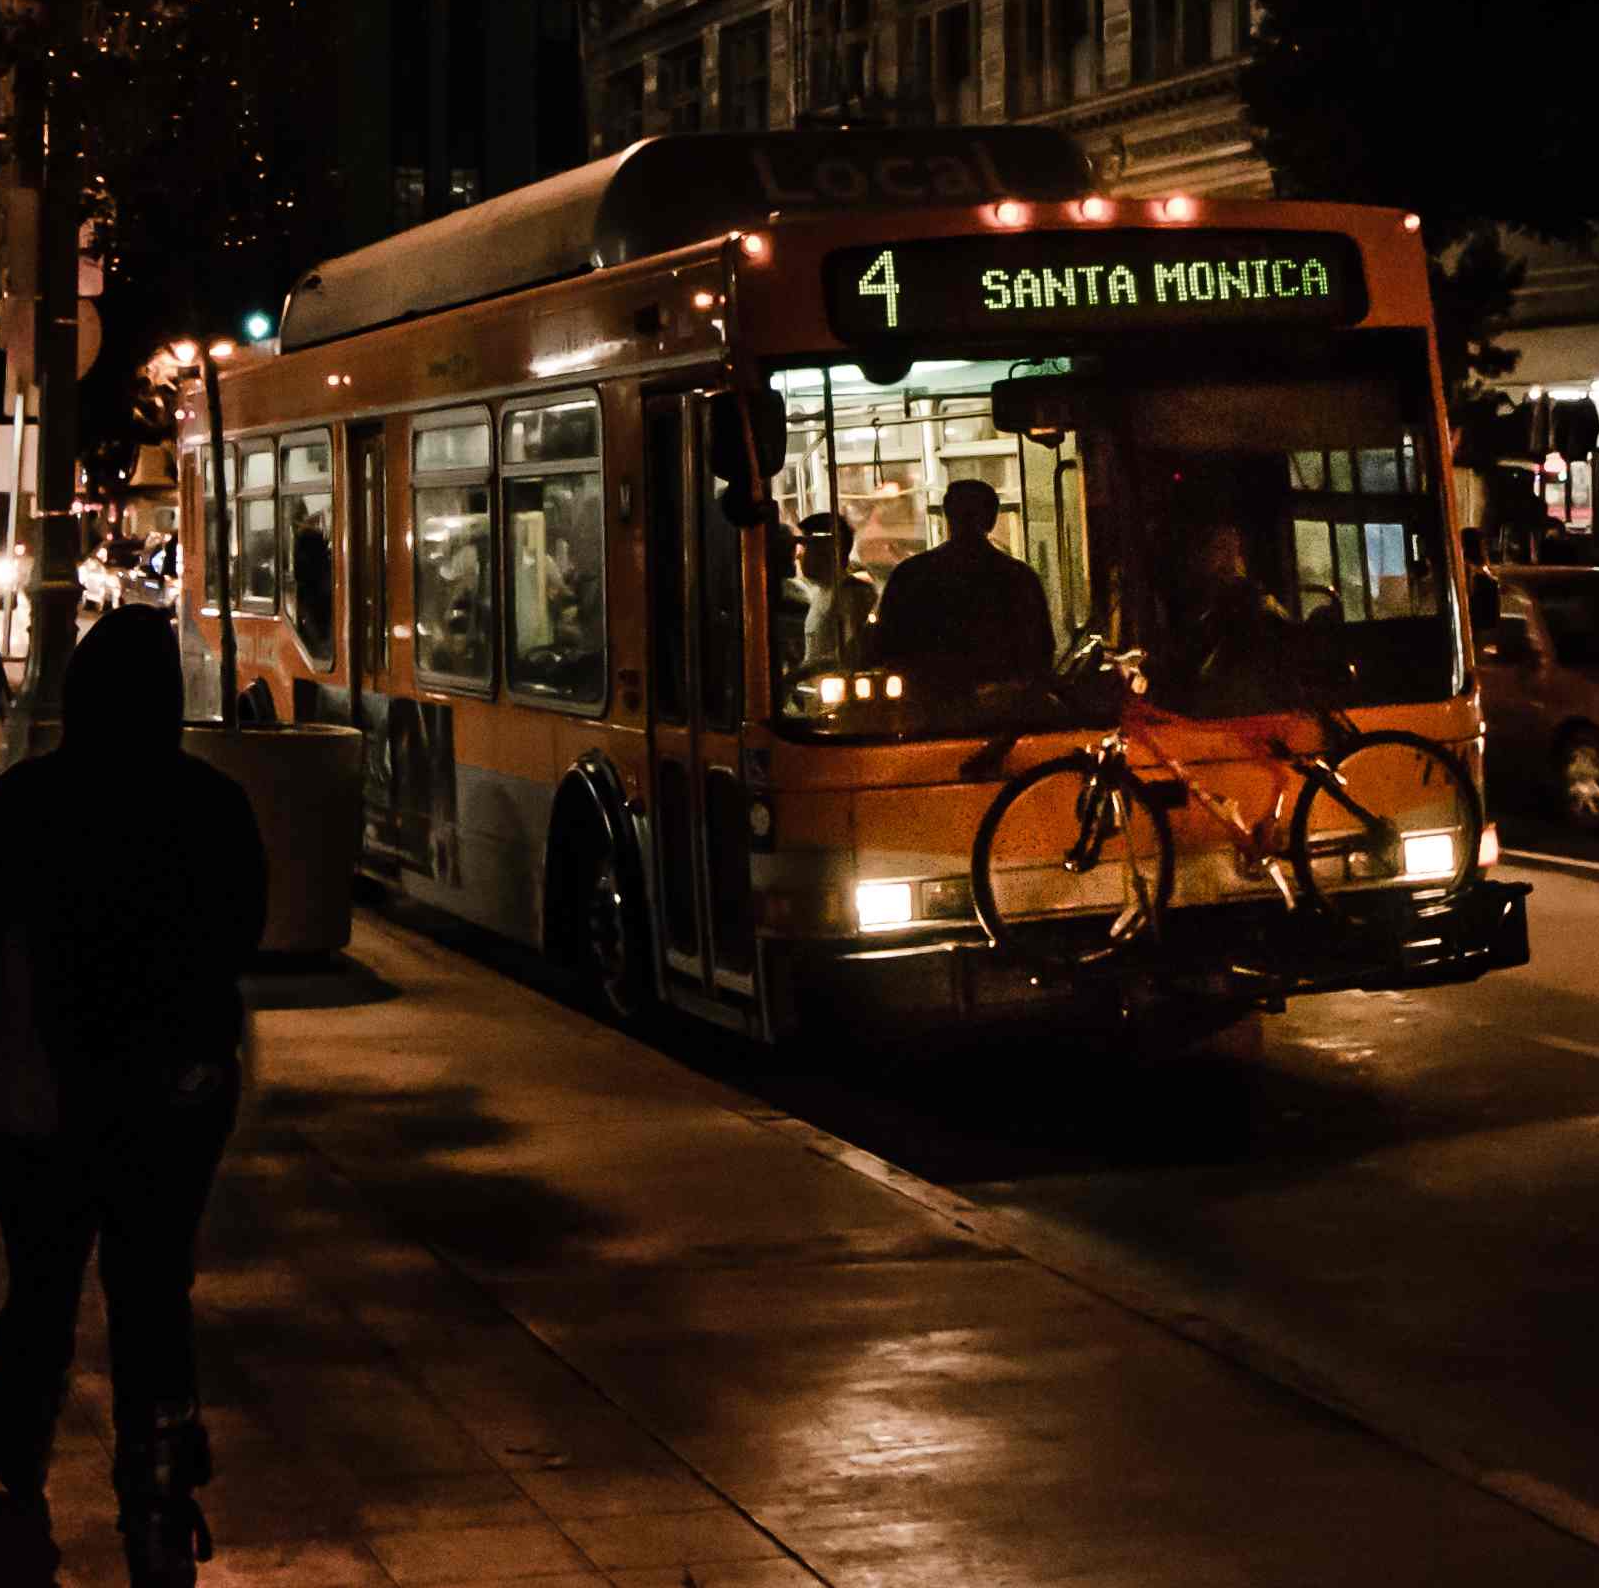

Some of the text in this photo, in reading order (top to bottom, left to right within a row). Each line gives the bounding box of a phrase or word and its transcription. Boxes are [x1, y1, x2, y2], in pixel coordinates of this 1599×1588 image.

[858, 249, 1330, 329] 4 SANTA MONICA
